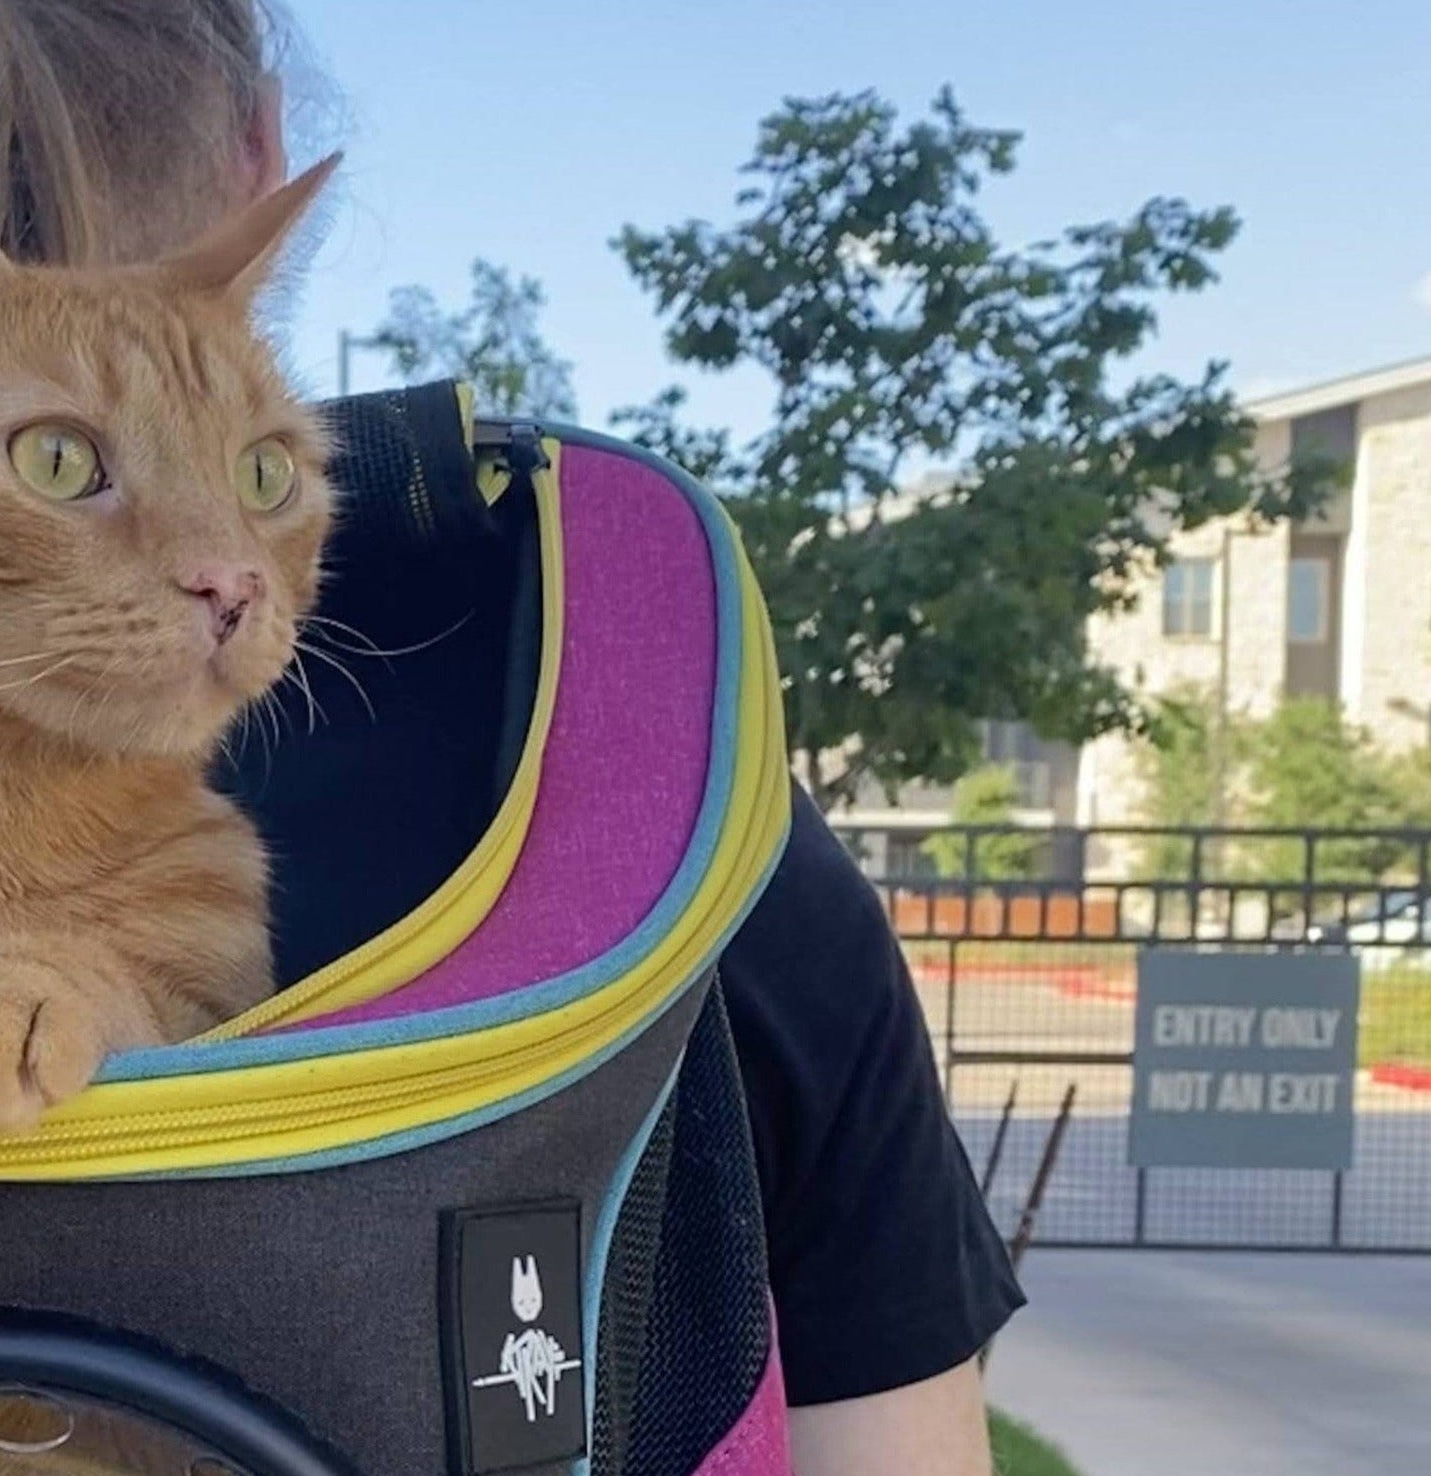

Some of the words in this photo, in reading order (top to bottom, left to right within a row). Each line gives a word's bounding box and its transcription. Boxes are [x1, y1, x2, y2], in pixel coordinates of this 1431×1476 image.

[1154, 1004, 1257, 1047] ENTRY
[1261, 1007, 1341, 1048] ONLY
[1148, 1071, 1212, 1112] NOT
[1216, 1072, 1264, 1112] AN
[1269, 1073, 1340, 1114] EXIT
